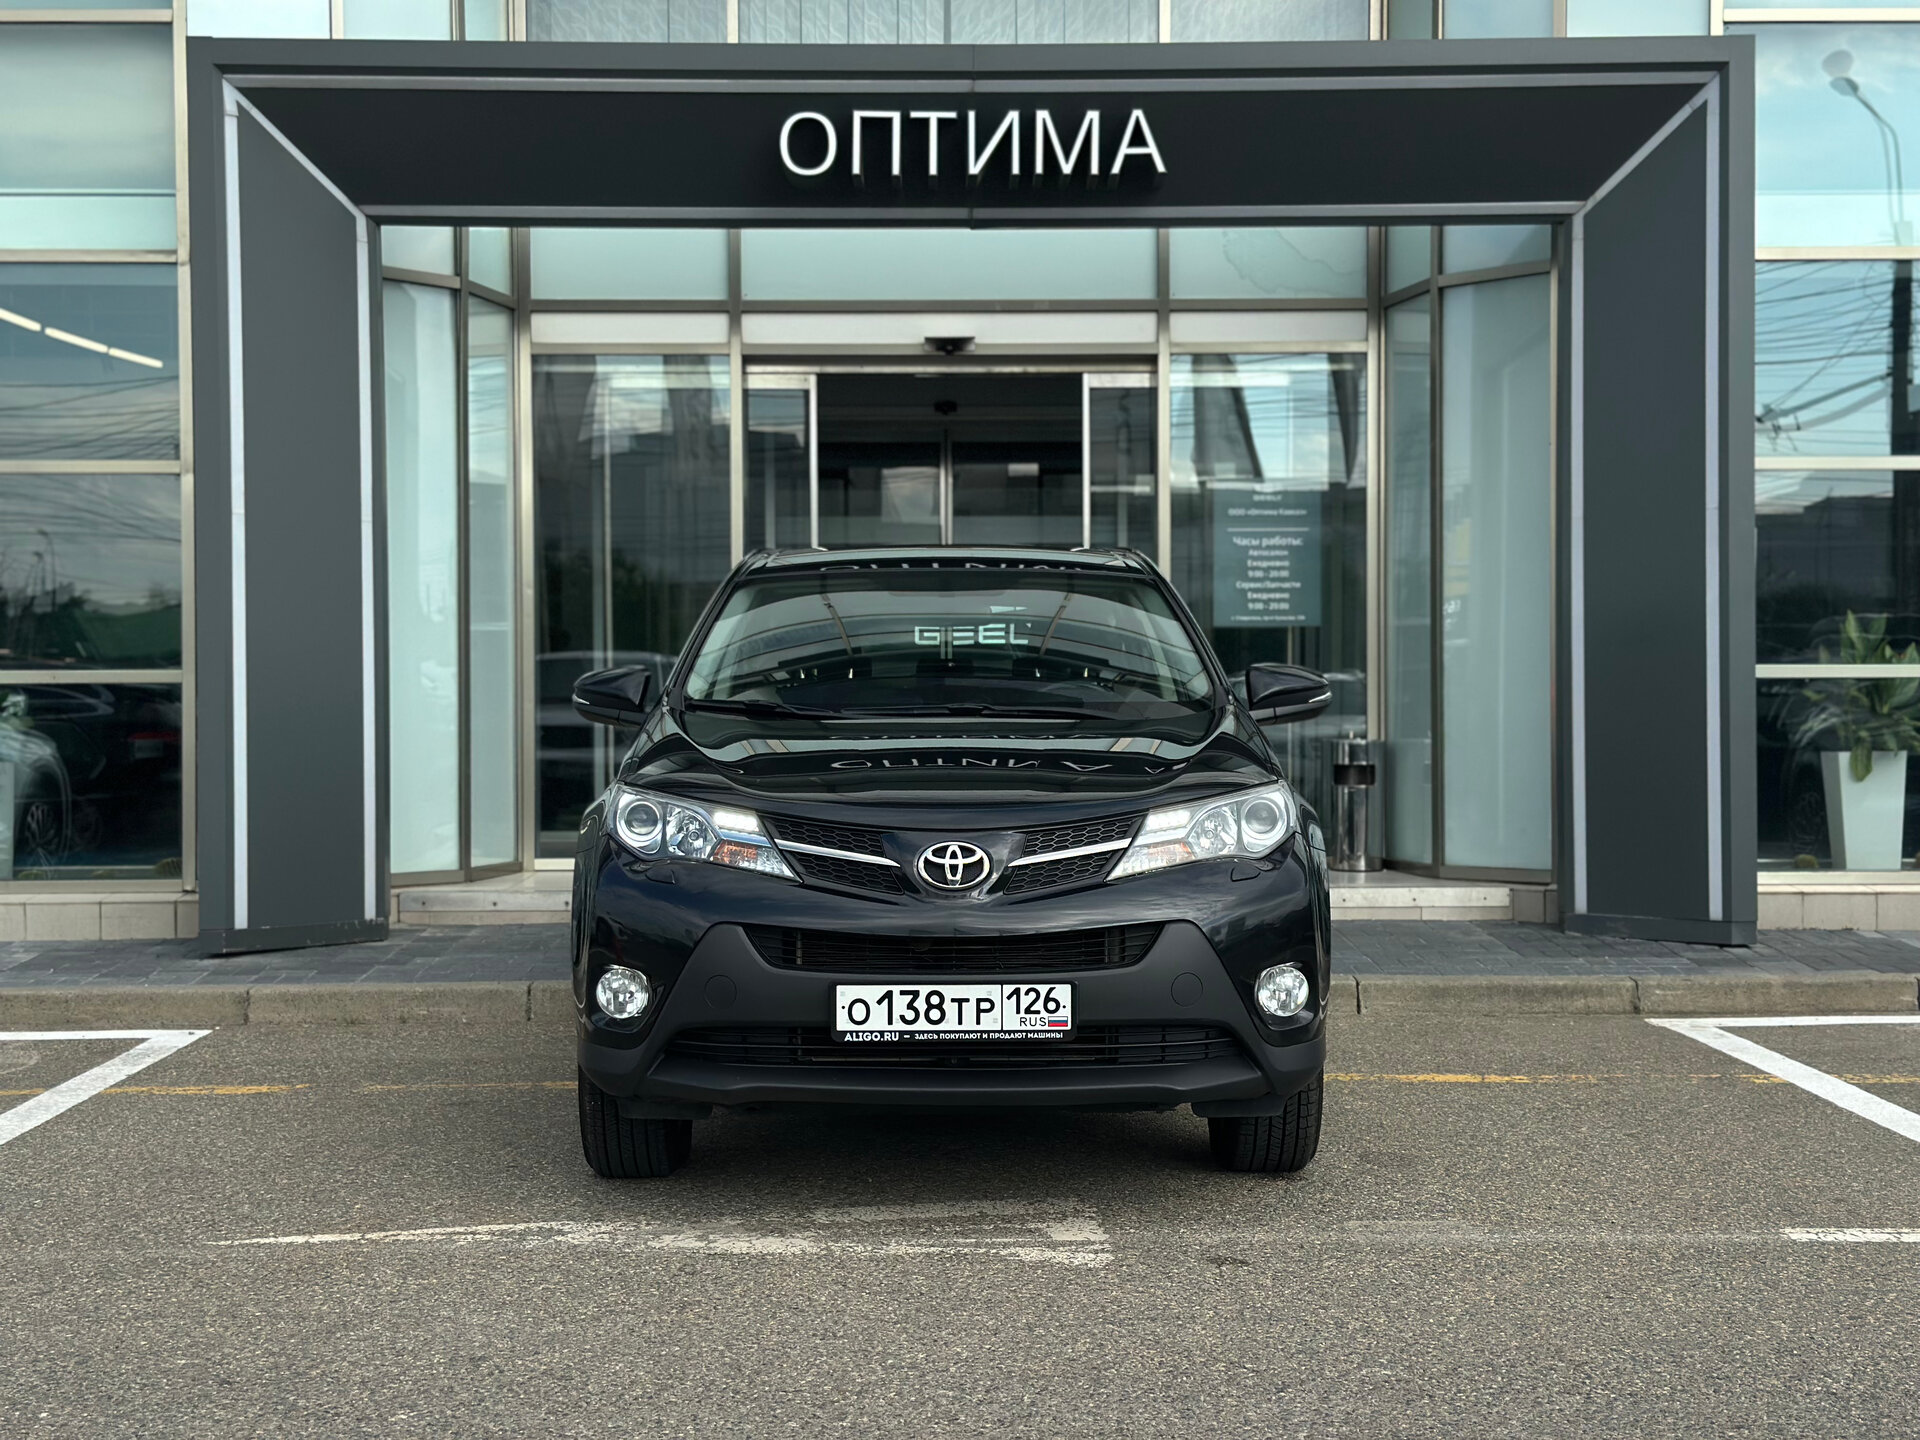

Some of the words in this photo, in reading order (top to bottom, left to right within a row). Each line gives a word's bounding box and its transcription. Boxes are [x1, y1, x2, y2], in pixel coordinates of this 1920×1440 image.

[779, 109, 1168, 175] ОПТИМА
[1232, 536, 1260, 547] Часы
[847, 990, 995, 1026] О138ТР
[1006, 987, 1061, 1015] 126
[1019, 1016, 1047, 1027] RUS
[844, 1032, 899, 1042] ALIGO.RU
[940, 1032, 981, 1040] ПОКУПАЮТ
